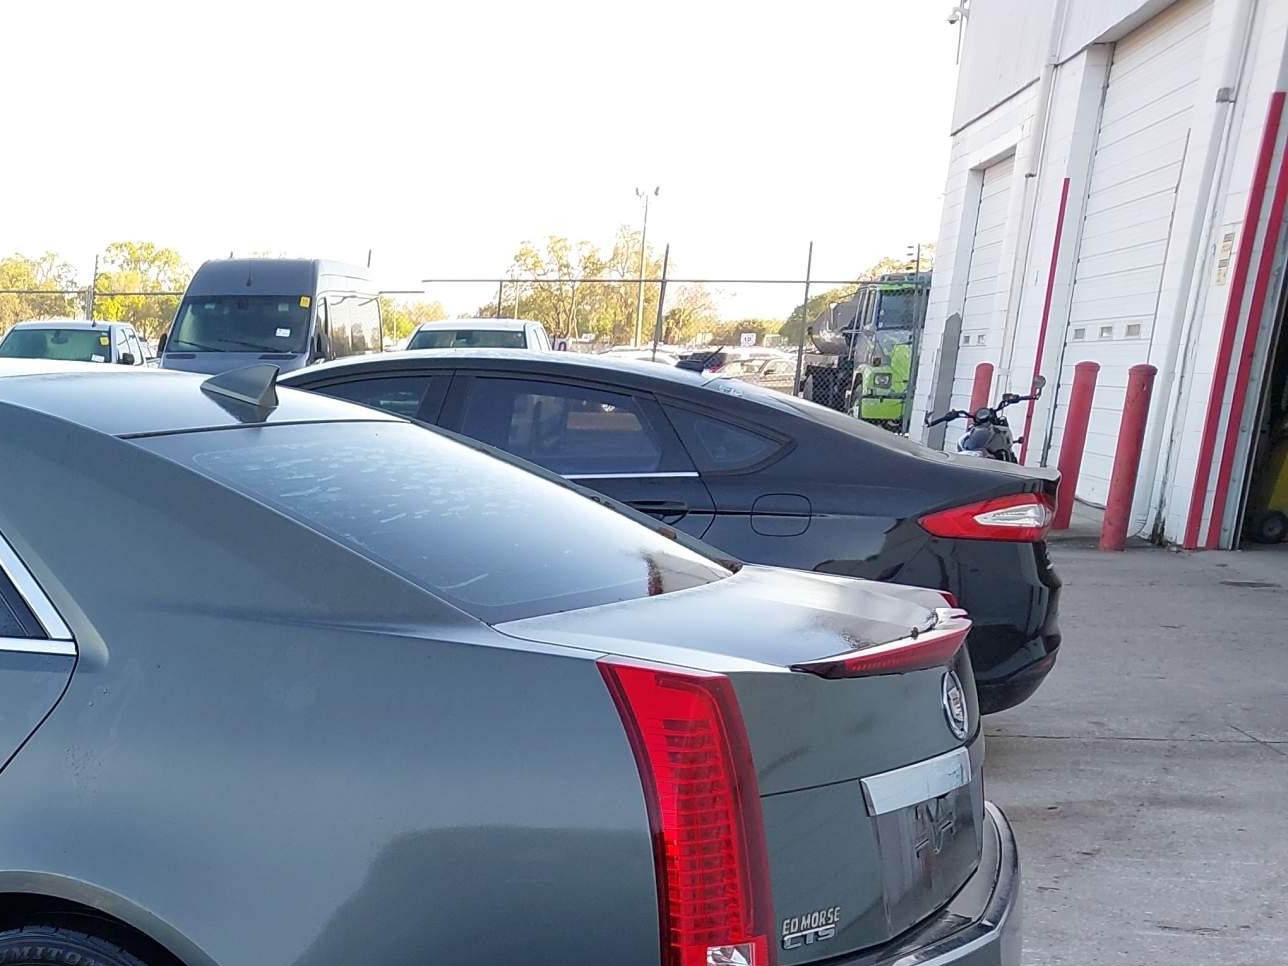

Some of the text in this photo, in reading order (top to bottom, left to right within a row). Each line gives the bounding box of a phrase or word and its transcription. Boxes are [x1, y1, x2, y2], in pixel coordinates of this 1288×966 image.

[782, 906, 841, 936] ED MORSE
[783, 923, 836, 950] CTS
